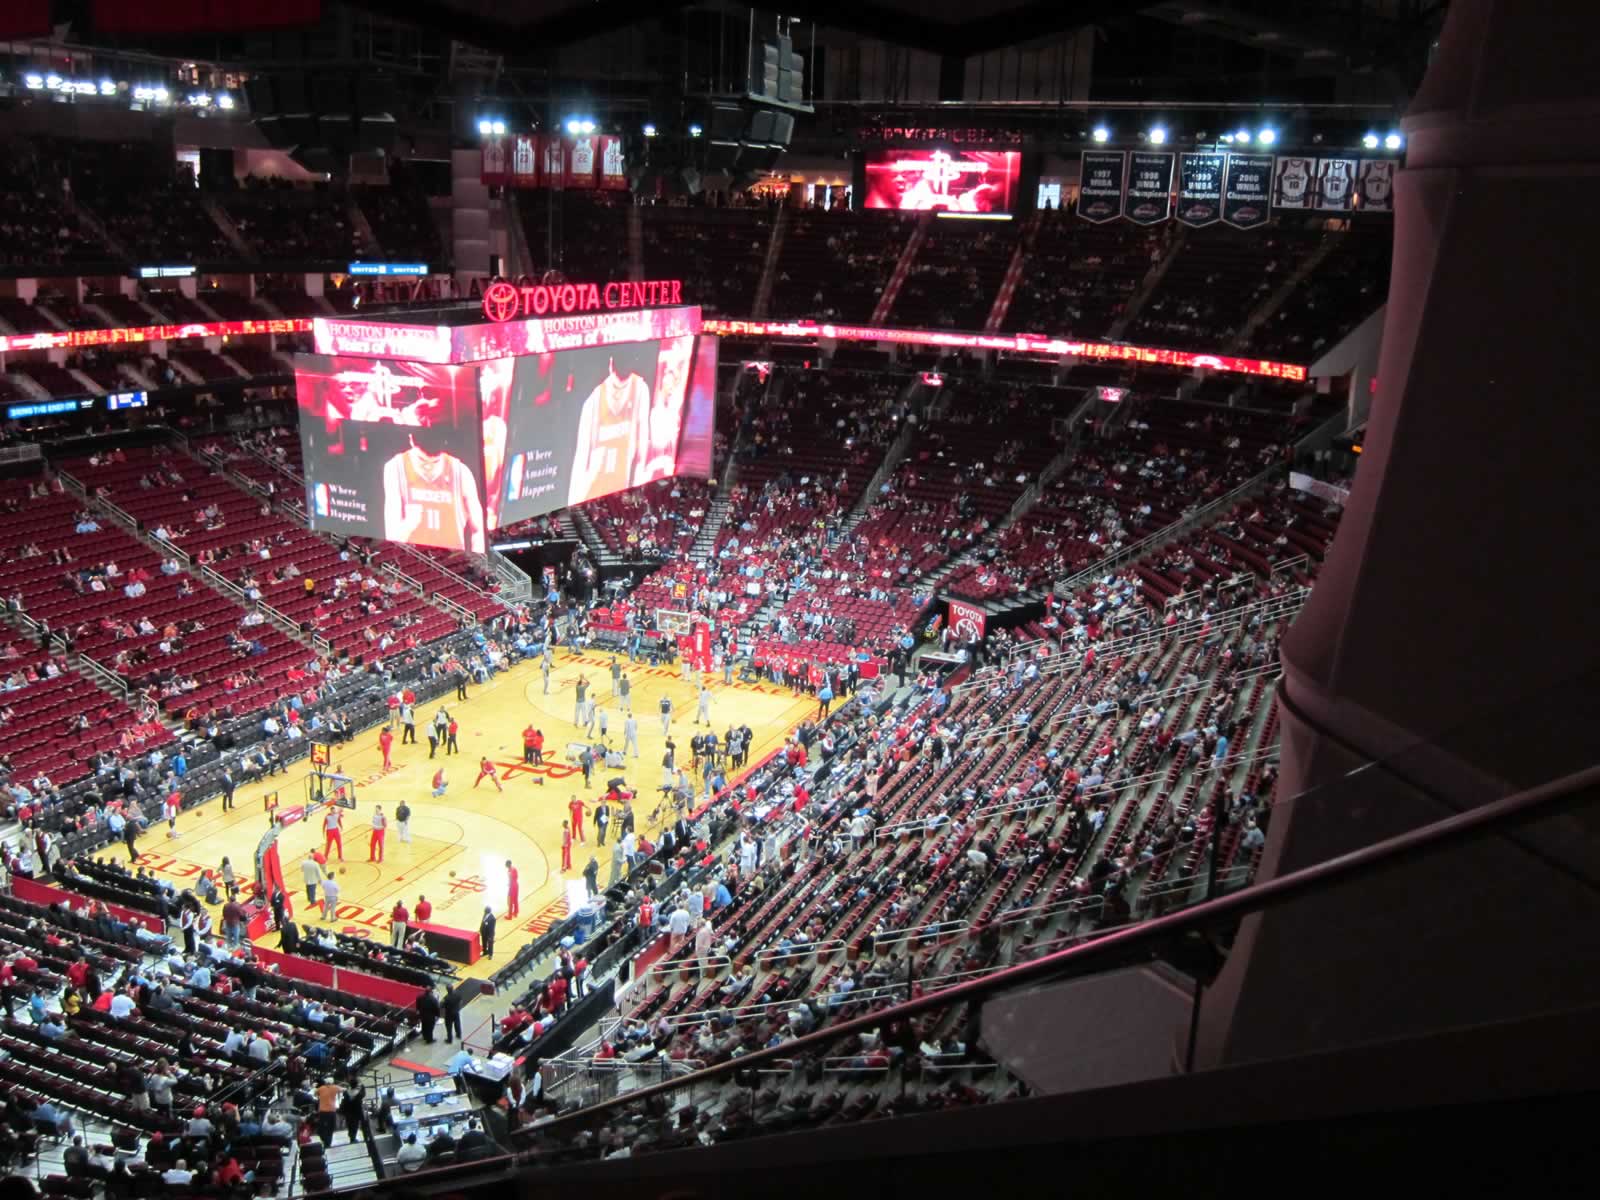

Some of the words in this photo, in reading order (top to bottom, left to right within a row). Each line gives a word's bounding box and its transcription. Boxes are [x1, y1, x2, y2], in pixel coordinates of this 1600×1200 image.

[1081, 187, 1121, 197] Champions
[1236, 183, 1260, 191] WNBA
[1128, 189, 1168, 199] Champions
[1180, 190, 1220, 200] Champions
[1227, 192, 1268, 202] Champions
[520, 283, 601, 315] TOYOTA
[604, 280, 683, 308] CENTER
[329, 323, 384, 338] HOUSTON
[543, 317, 595, 333] HOUSTON
[527, 450, 553, 461] Where
[525, 464, 558, 480] Amazing
[329, 483, 357, 496] Where
[330, 498, 367, 512] Amazing
[952, 604, 984, 623] TOYOTA
